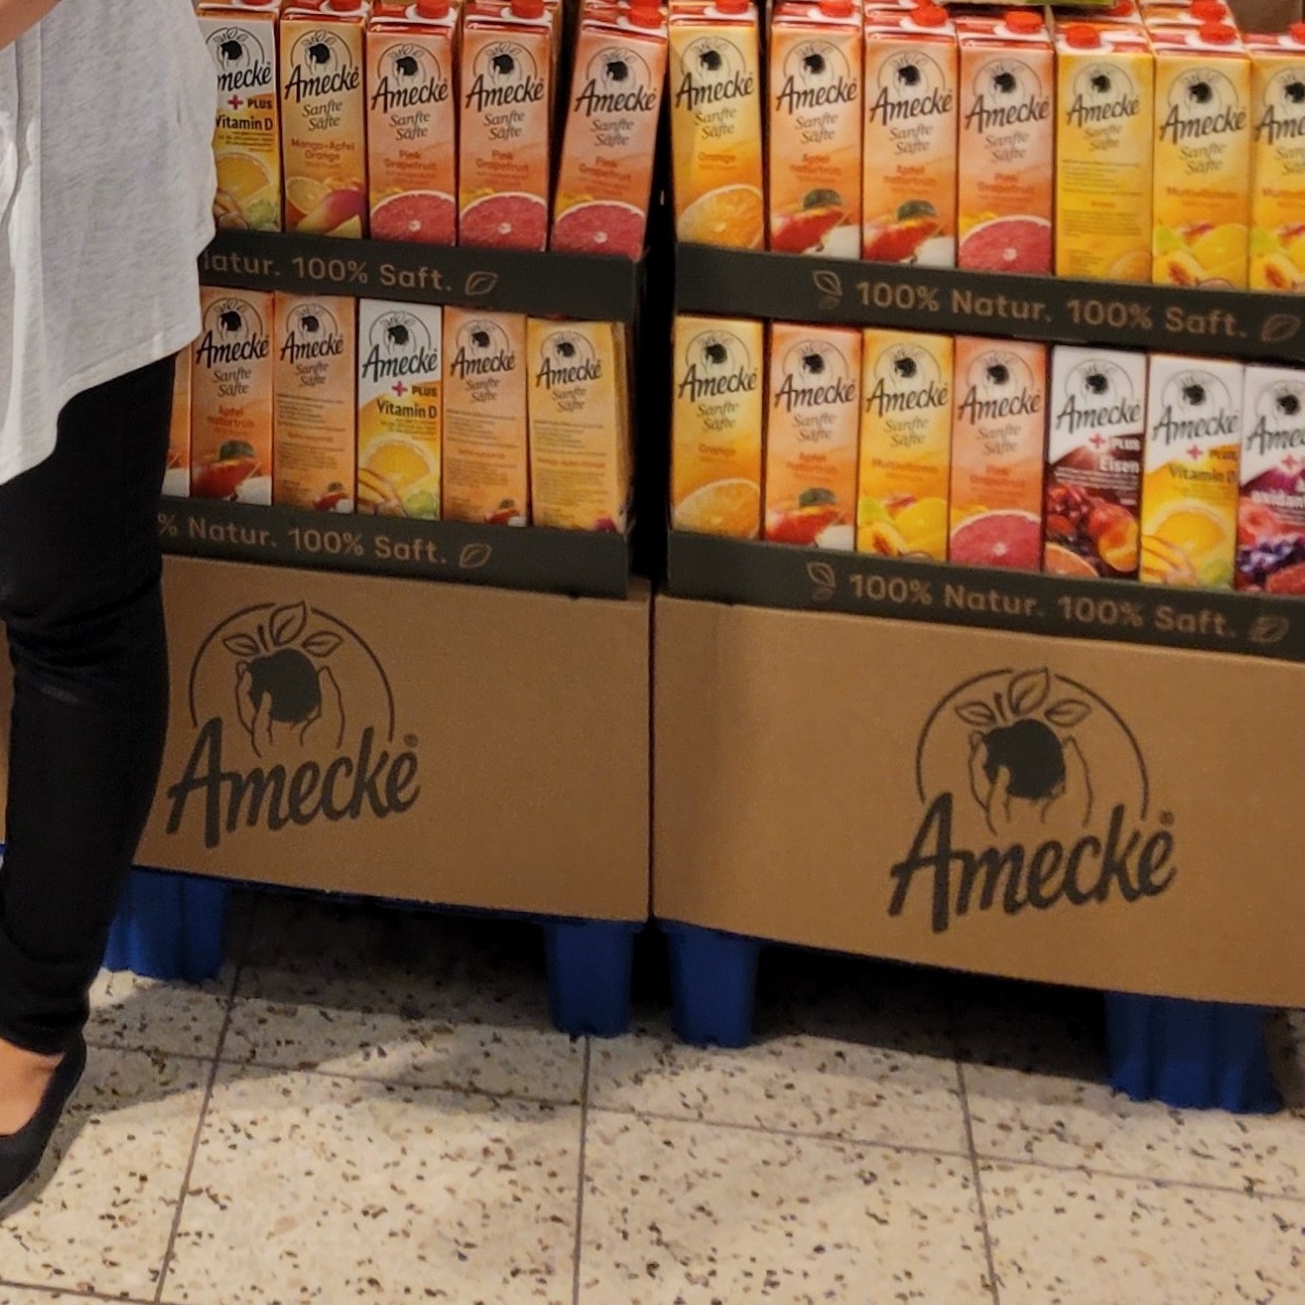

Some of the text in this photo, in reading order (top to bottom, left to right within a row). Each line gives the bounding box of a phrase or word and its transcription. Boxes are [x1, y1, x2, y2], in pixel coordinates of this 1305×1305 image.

[215, 61, 272, 93] mecke
[284, 64, 361, 103] Amecke
[371, 74, 449, 114] Amecke
[465, 73, 544, 113] Amecke
[574, 74, 657, 115] Amecke
[675, 71, 755, 111] Amecke
[776, 74, 858, 115] Amecke
[247, 97, 273, 110] PLUS
[263, 116, 274, 130] D
[301, 98, 344, 118] Sanfte
[388, 109, 431, 129] Sanfte
[483, 107, 526, 127] Sanfte
[869, 85, 953, 126] Amecke
[965, 94, 1050, 134] Amecke
[1066, 94, 1140, 127] Amecke
[590, 116, 635, 133] Sanfte
[1159, 103, 1247, 145] Amecke
[292, 256, 369, 284] 100%
[379, 262, 453, 292] Saft.
[855, 280, 1248, 338] 100% Natur. 100% Saft.
[196, 329, 270, 369] Amecke
[280, 332, 344, 366] Amecke
[362, 344, 438, 383] Amecke
[450, 345, 516, 379] Amecke
[411, 384, 438, 398] PLUS
[535, 355, 603, 390] Amecke
[678, 363, 758, 402] Amecke
[376, 399, 438, 419] Vitamin D
[774, 373, 855, 413] Amecke
[866, 378, 949, 417] Amecke
[958, 384, 1042, 425] Amecke
[1056, 394, 1142, 435] Amecke
[1152, 405, 1240, 446] Amecke
[1099, 455, 1140, 474] Eisen
[1169, 465, 1224, 483] Vitamin
[188, 518, 278, 549] Natur.
[288, 527, 365, 557] 100%
[374, 535, 447, 566] Saft.
[849, 573, 1237, 639] 100% Natur. 100% Saft.
[165, 716, 422, 849] Amecke
[888, 792, 1177, 933] Amecke
